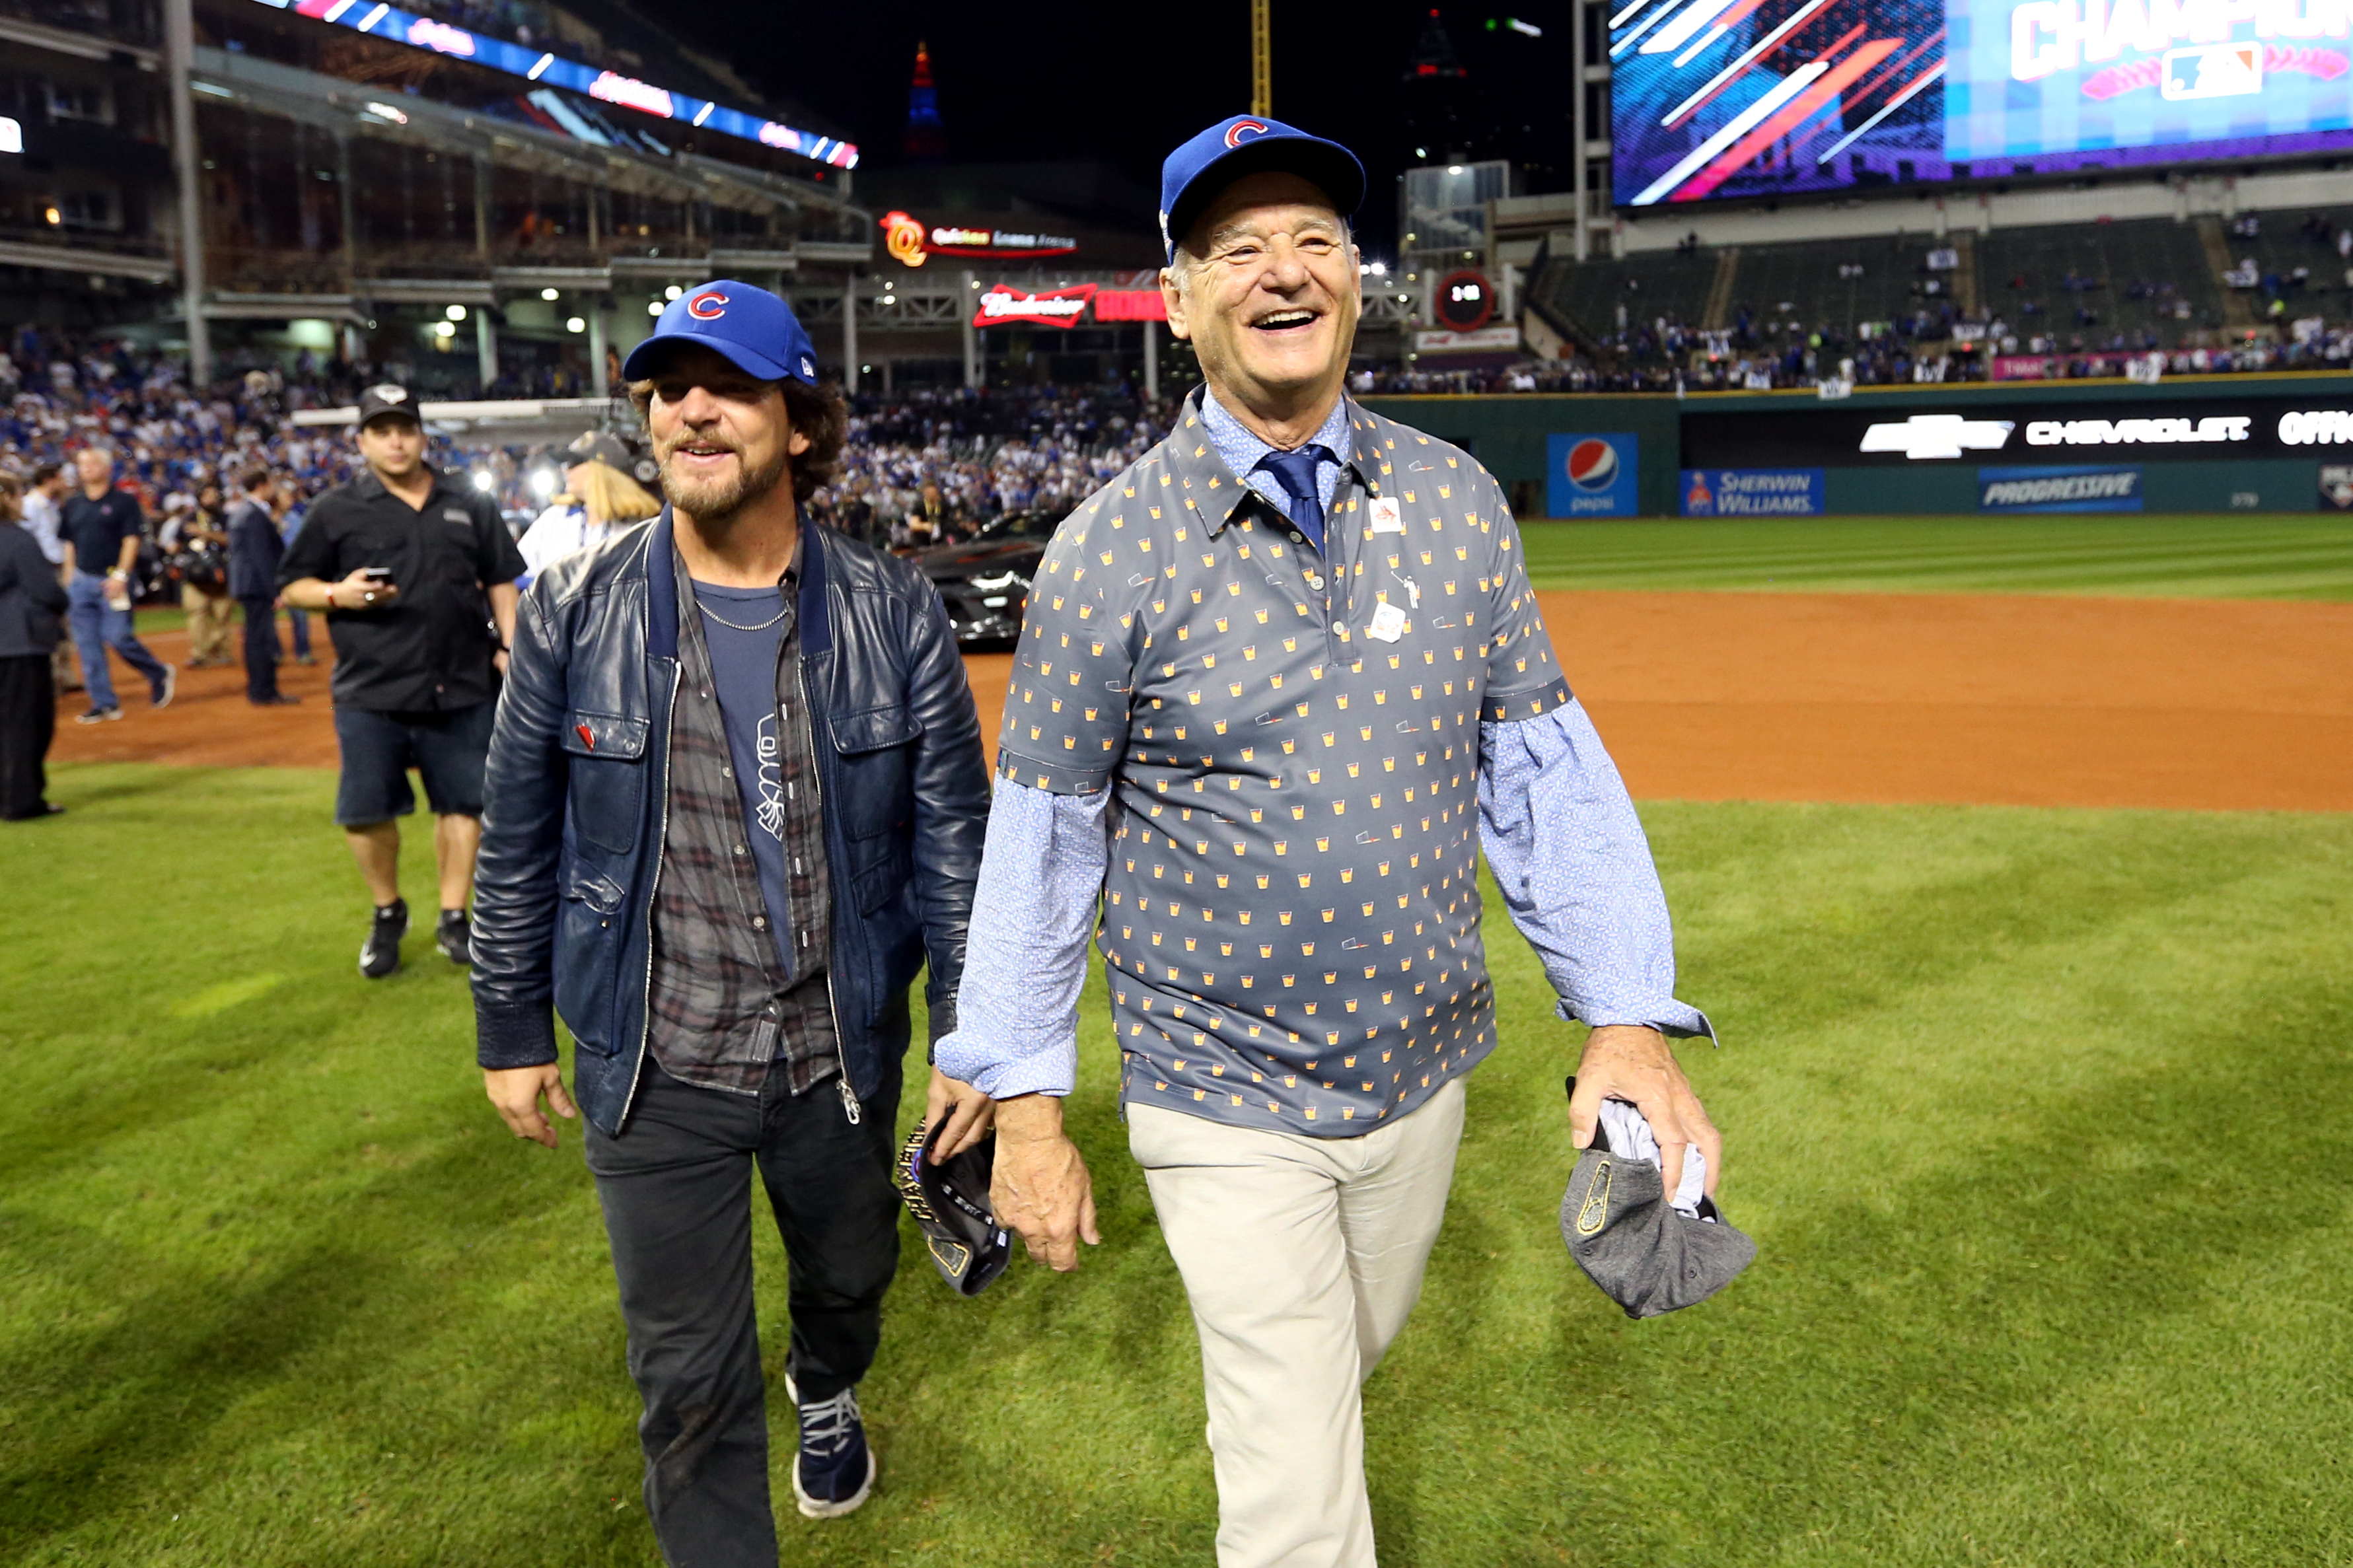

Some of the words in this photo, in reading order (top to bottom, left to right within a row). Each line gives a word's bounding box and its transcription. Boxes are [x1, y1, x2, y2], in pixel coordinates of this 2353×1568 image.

[687, 291, 730, 321] C
[2026, 416, 2251, 445] CHEVROLET
[2278, 410, 2353, 445] OFFI
[1719, 472, 1812, 493] SHERWIN
[1984, 472, 2138, 506] PROGRESSIVE
[1571, 495, 1614, 513] pepsi
